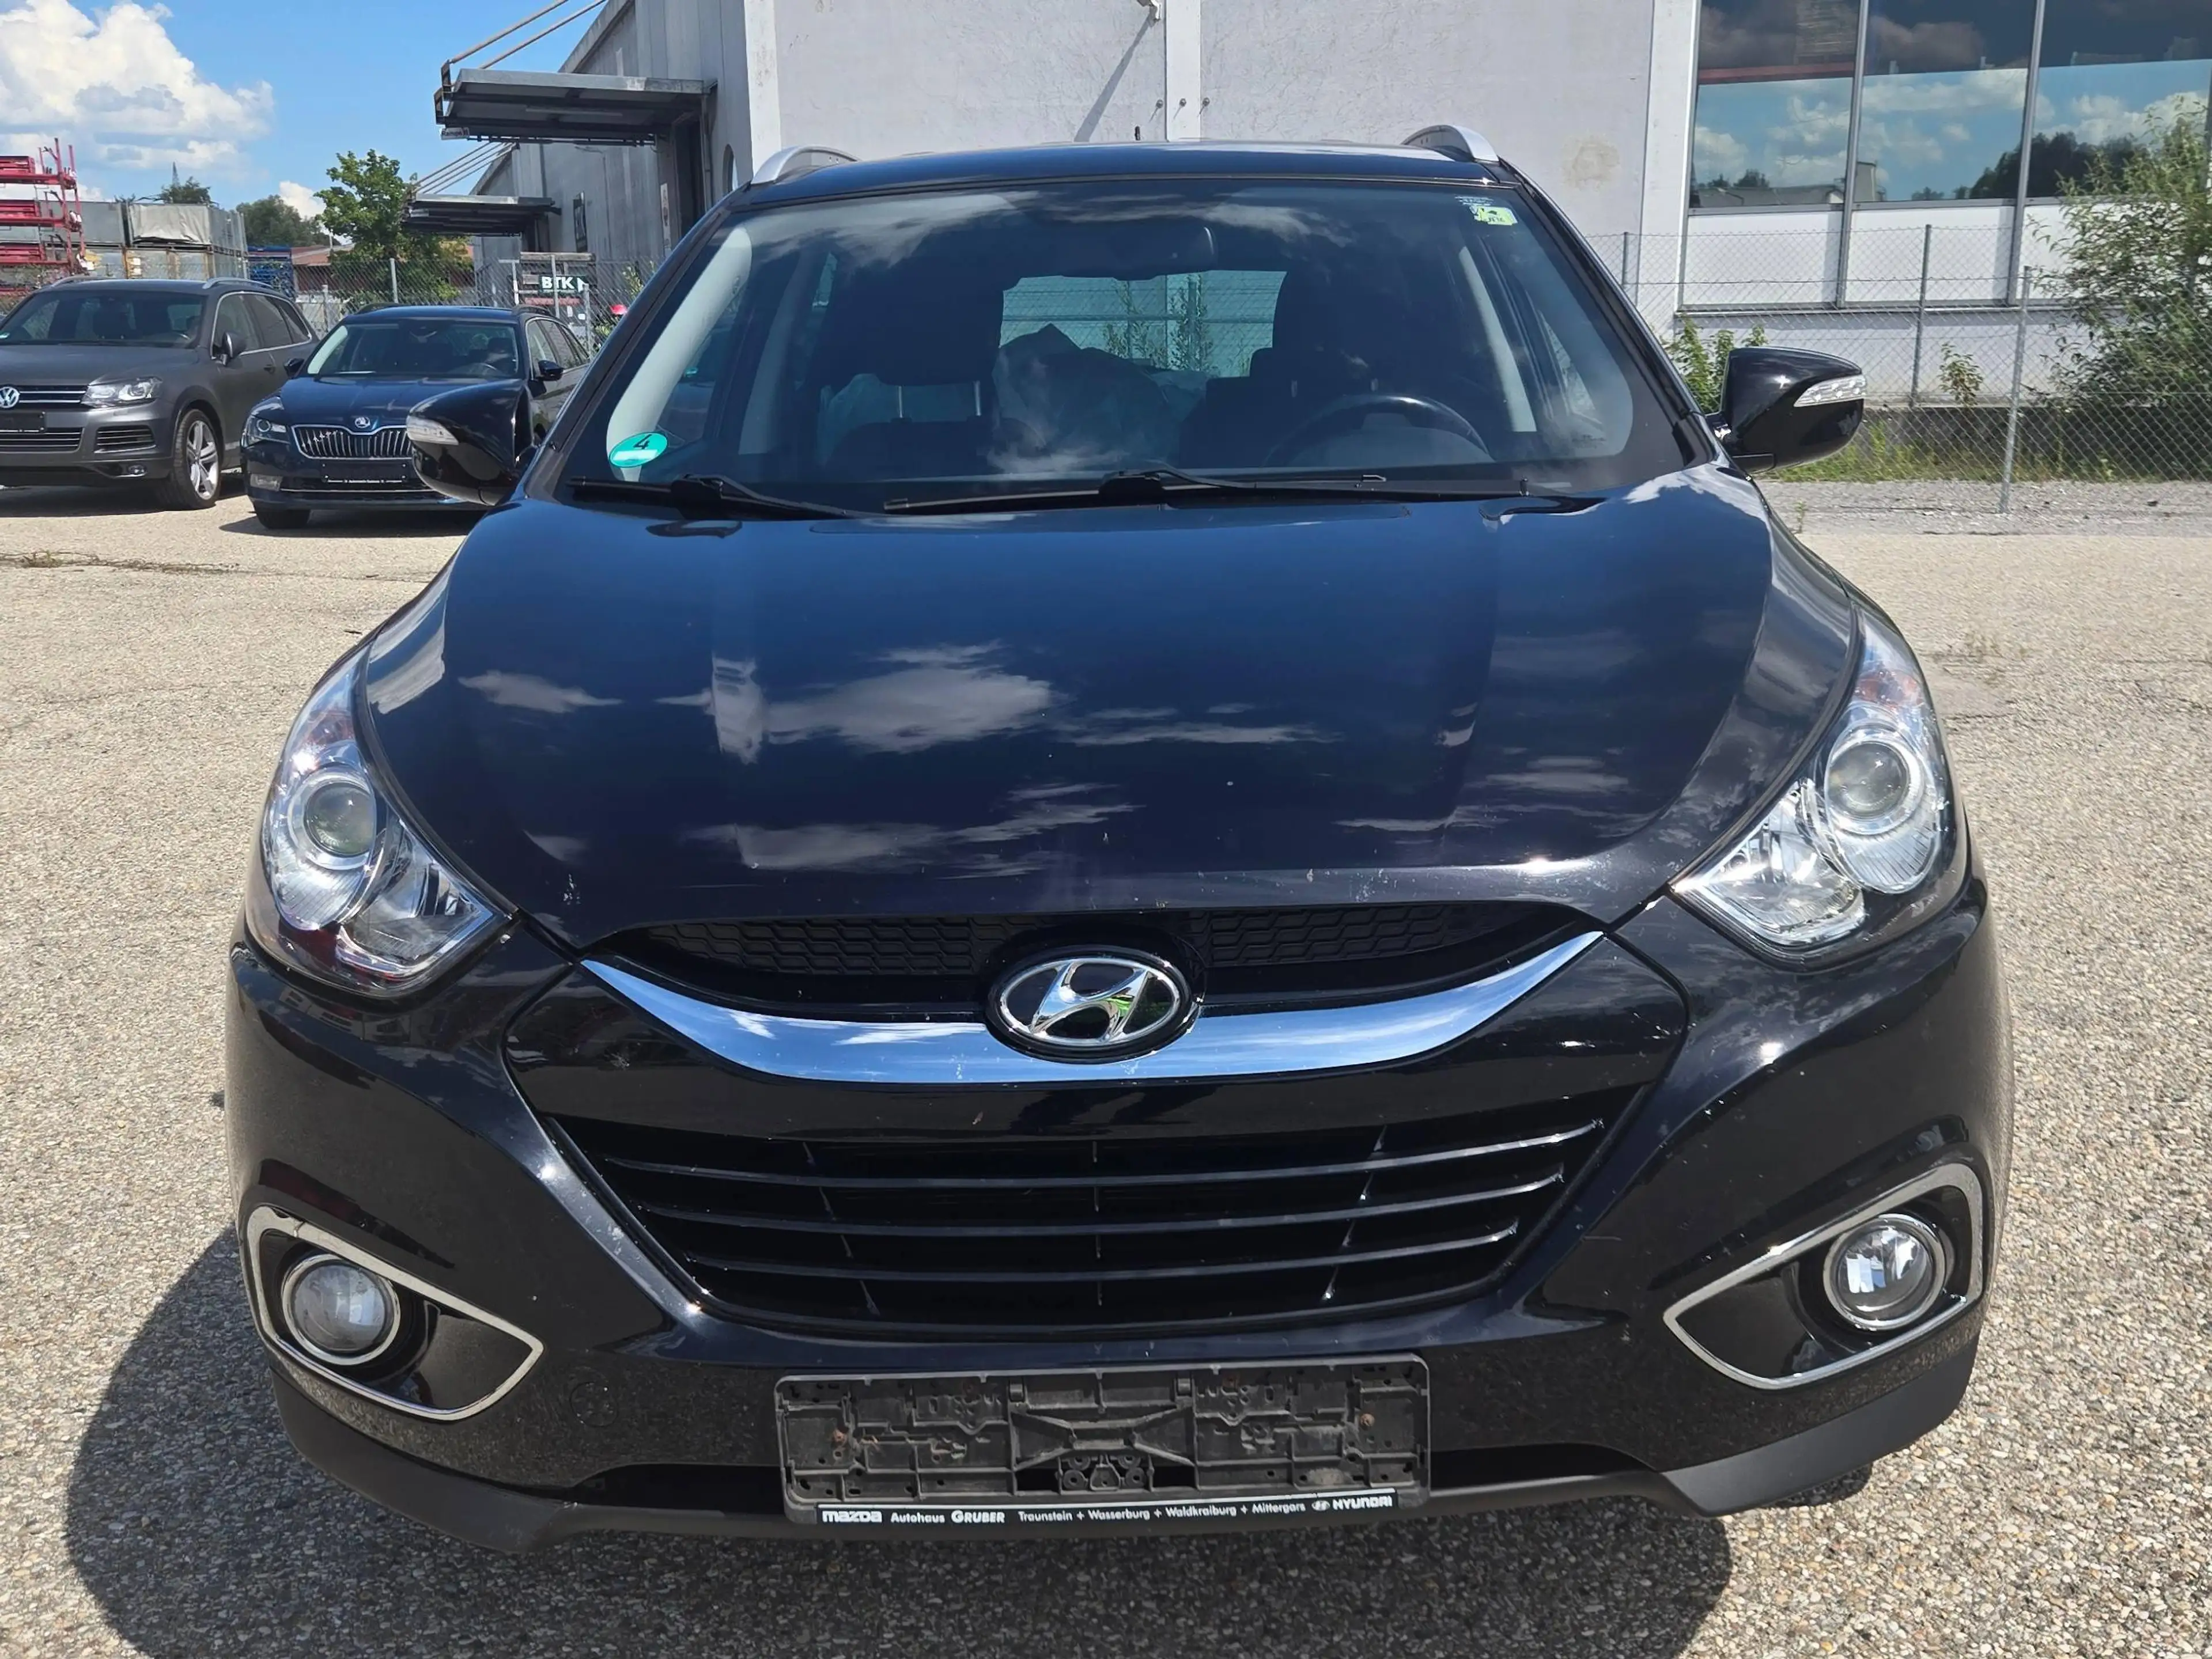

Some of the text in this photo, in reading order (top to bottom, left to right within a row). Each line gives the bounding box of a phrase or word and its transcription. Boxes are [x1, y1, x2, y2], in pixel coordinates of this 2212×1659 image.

[541, 276, 575, 289] BTK
[633, 434, 652, 449] 4
[890, 1512, 946, 1524] Autohaus
[951, 1509, 1005, 1524] GRUBER
[1018, 1510, 1073, 1522] Traunstein
[1087, 1508, 1151, 1521] Wasserburg
[1165, 1505, 1237, 1517] Waldkraiburg
[1251, 1502, 1306, 1514] Mittergars
[1332, 1495, 1393, 1510] HYUNDAI
